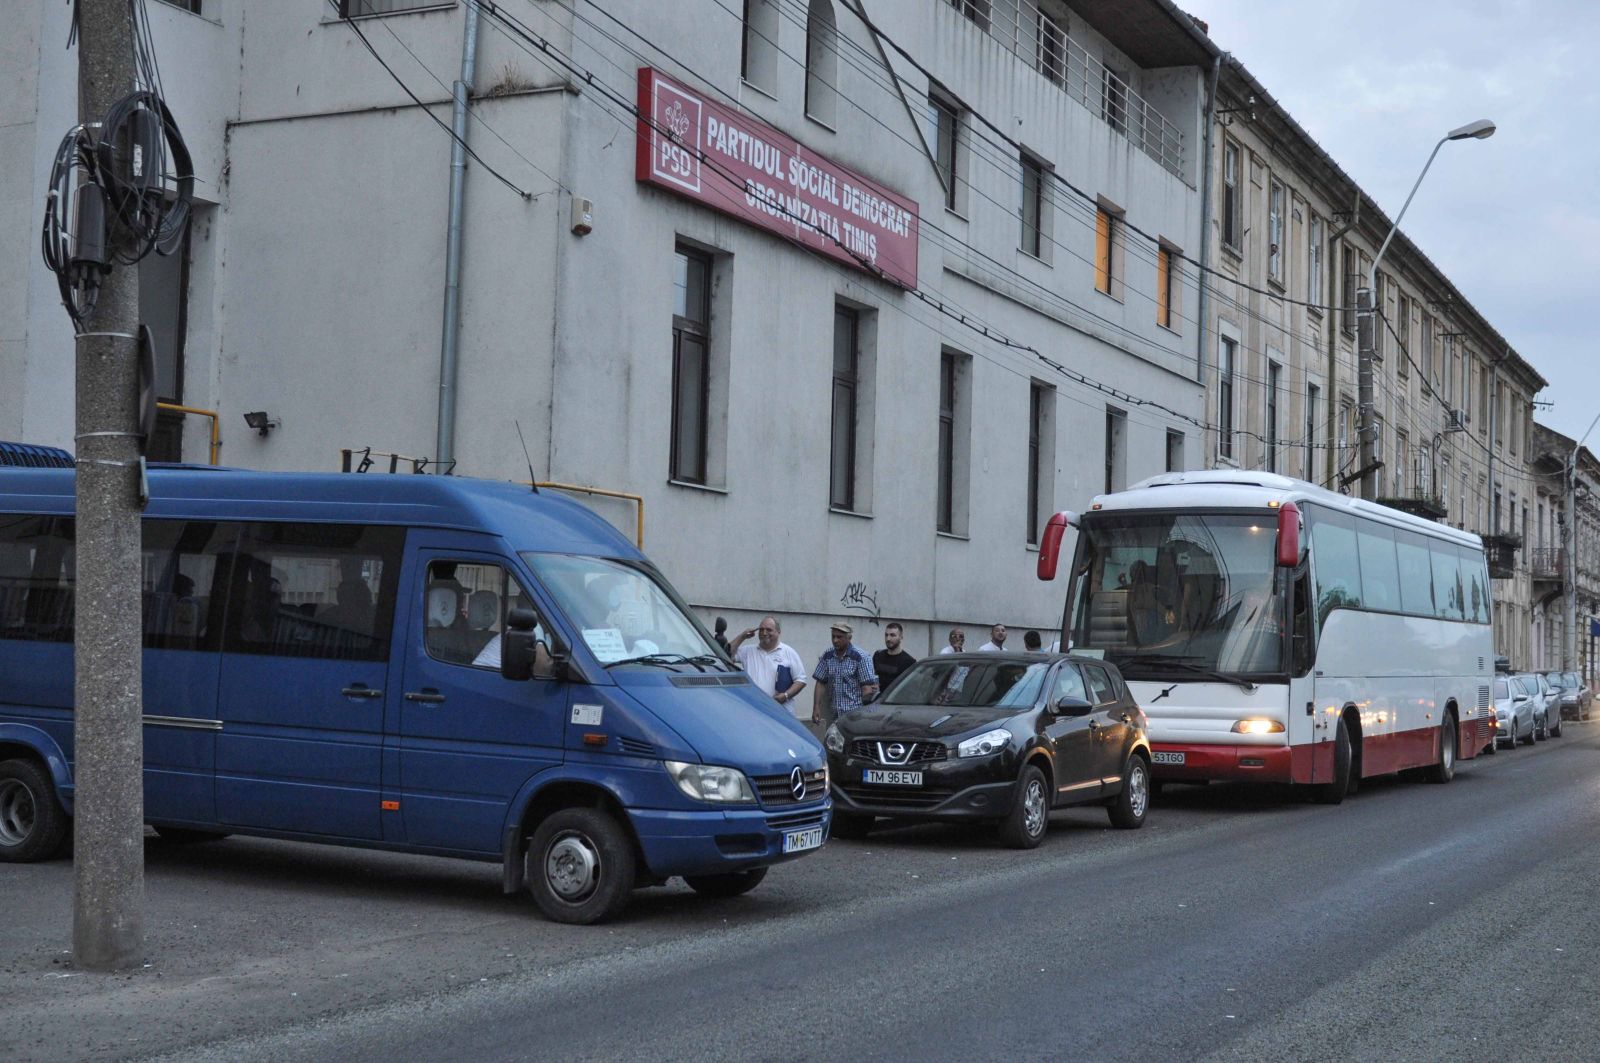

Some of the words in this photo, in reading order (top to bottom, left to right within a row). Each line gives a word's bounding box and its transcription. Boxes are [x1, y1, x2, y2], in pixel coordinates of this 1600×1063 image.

[661, 140, 690, 177] PSD
[707, 116, 784, 180] PARTIDUL
[788, 156, 839, 206] SOCIAL
[842, 183, 911, 238] DEMOCRAT
[1154, 753, 1165, 762] 53
[1166, 753, 1184, 763] TGO
[870, 771, 884, 782] TM
[887, 772, 900, 783] 96
[902, 772, 920, 784] EVI
[788, 834, 799, 850] TM
[800, 832, 809, 848] 67
[809, 829, 821, 846] VTT
